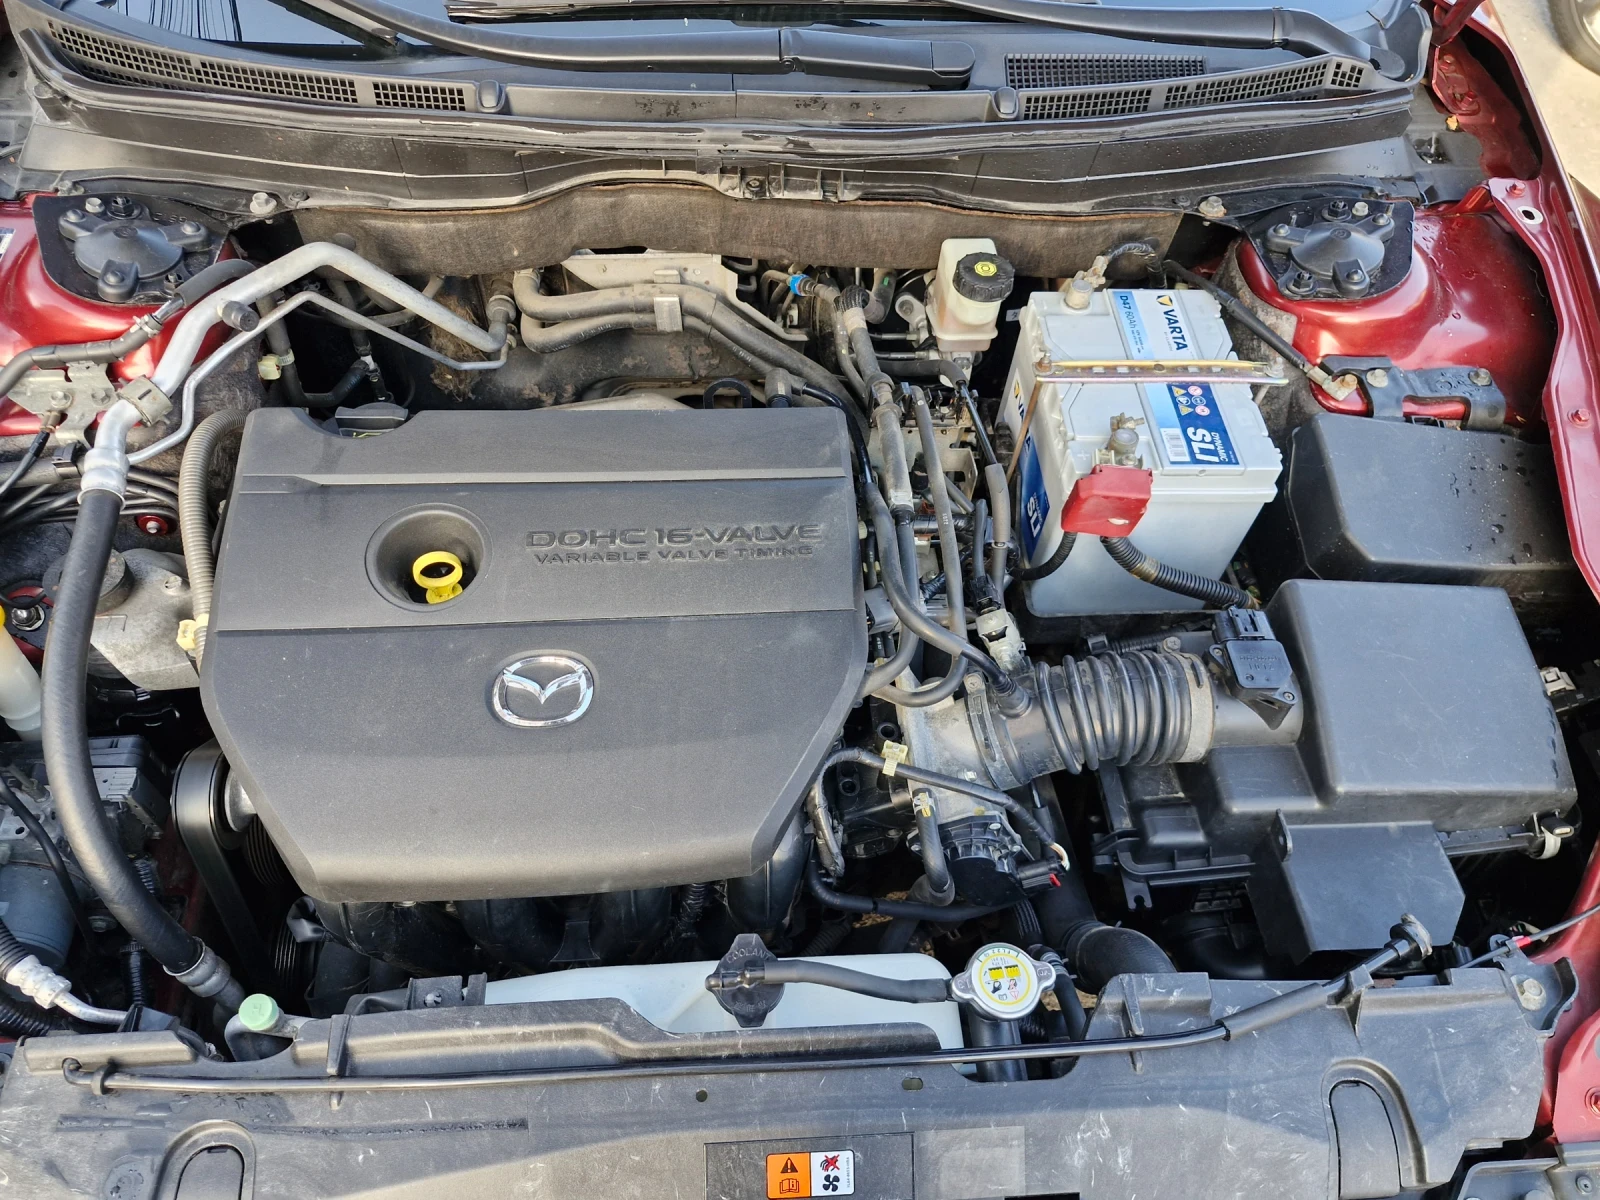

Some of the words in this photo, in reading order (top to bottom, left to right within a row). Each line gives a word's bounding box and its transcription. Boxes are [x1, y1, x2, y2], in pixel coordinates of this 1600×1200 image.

[1119, 295, 1132, 310] D47
[1125, 311, 1136, 329] 60Ah
[1163, 308, 1188, 351] VARTA
[1186, 426, 1220, 463] SLI
[1211, 431, 1228, 462] DYNAMIC
[1027, 496, 1041, 538] SLI
[525, 528, 647, 548] DOHC
[654, 524, 823, 546] 16-VALVE
[534, 552, 650, 564] VARIABLE
[657, 550, 728, 562] VALVE
[735, 546, 813, 560] TIMING
[726, 948, 771, 963] COOLANT
